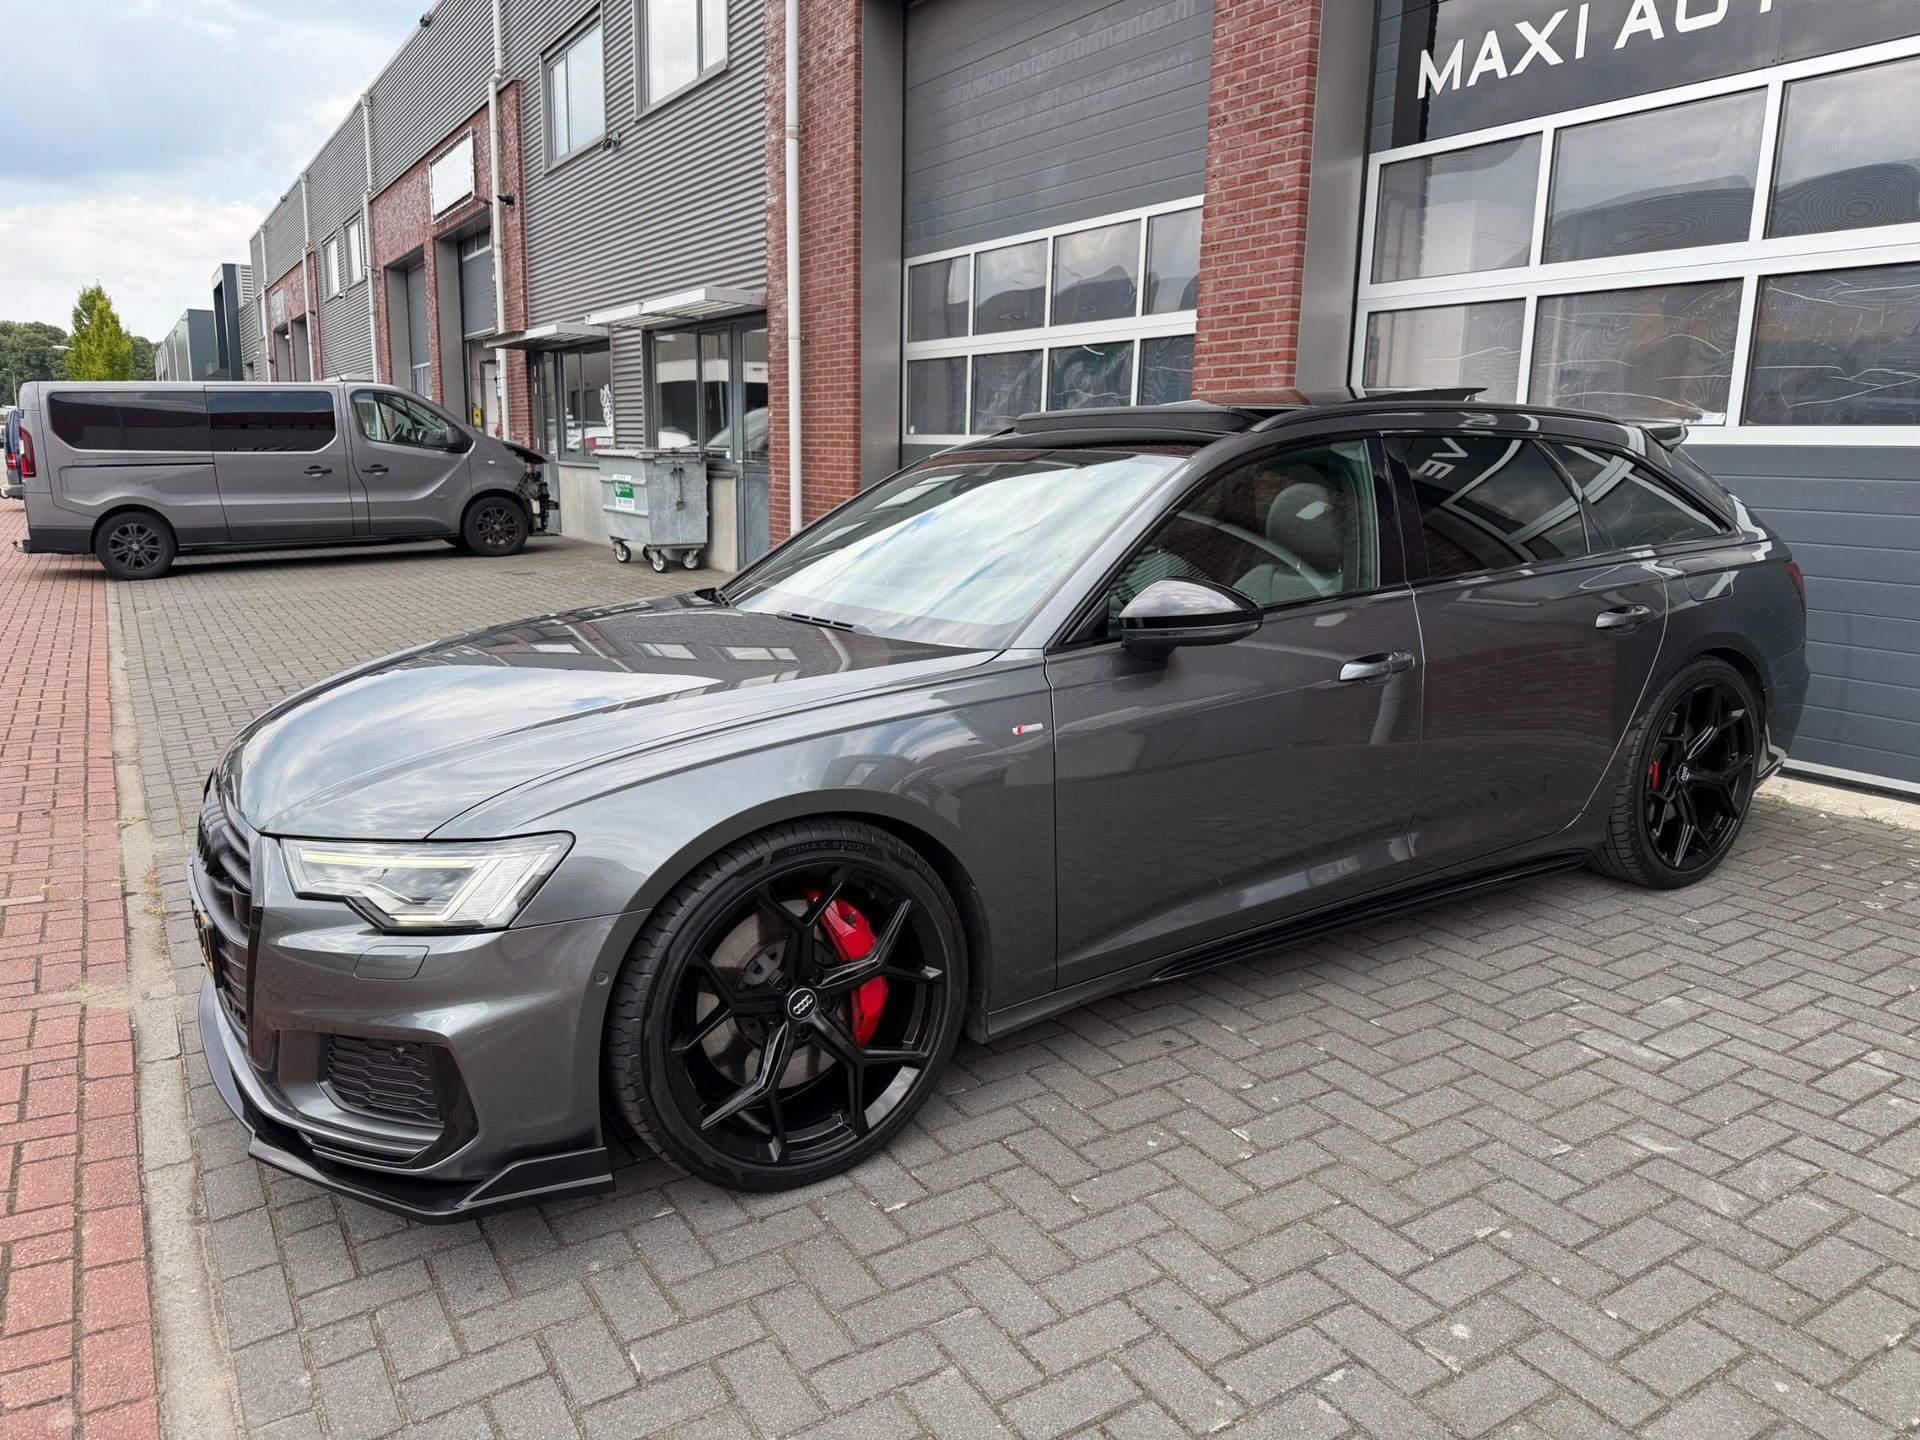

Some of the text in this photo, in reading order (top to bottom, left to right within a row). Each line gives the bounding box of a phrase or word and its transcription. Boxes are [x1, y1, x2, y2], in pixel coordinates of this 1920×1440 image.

[1417, 3, 1590, 99] MAXI
[788, 841, 871, 856] DIMAX SPORT
